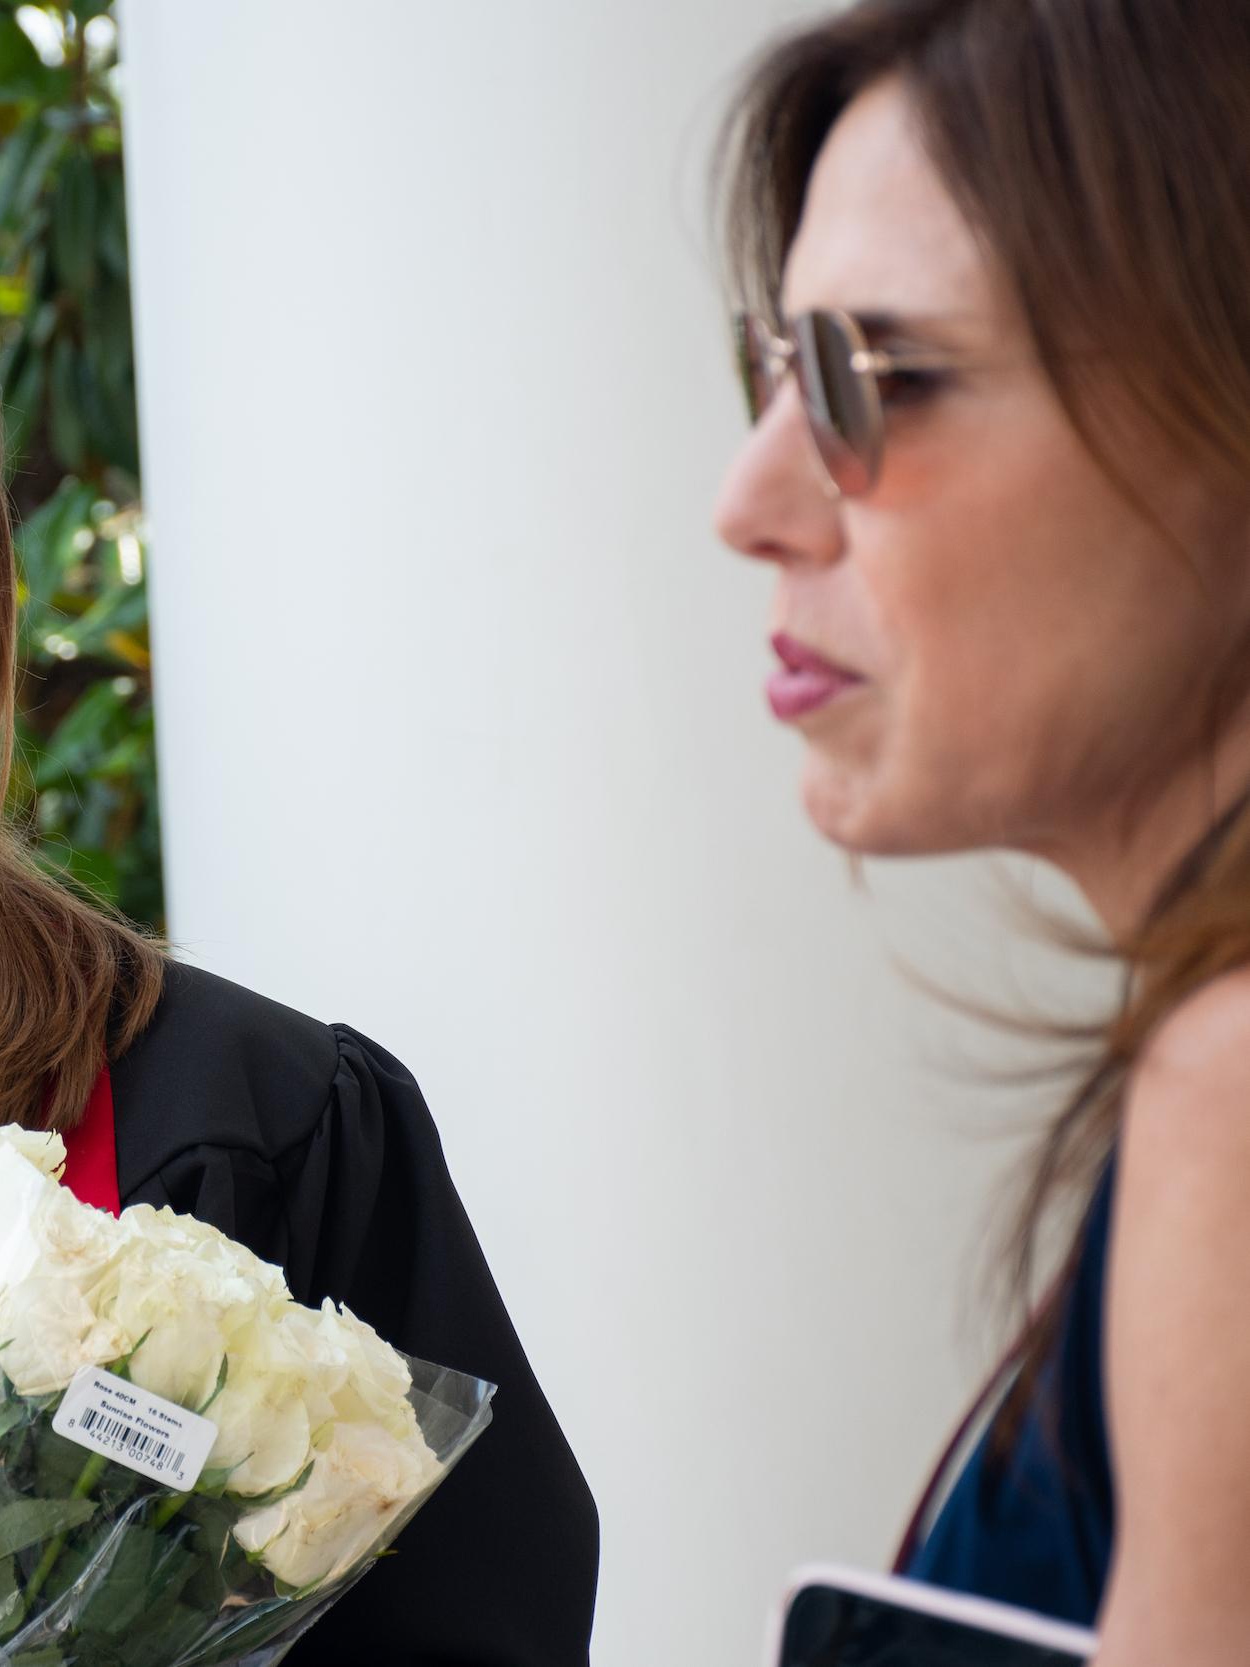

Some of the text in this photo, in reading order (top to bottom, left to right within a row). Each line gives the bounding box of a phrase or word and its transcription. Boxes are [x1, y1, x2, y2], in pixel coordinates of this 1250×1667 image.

[93, 1380, 113, 1394] Rose
[115, 1391, 137, 1406] 40CM
[159, 1411, 183, 1428] Stems
[100, 1400, 170, 1439] Sunrise Flowers
[68, 1418, 184, 1481] 8 44213 00748 3
